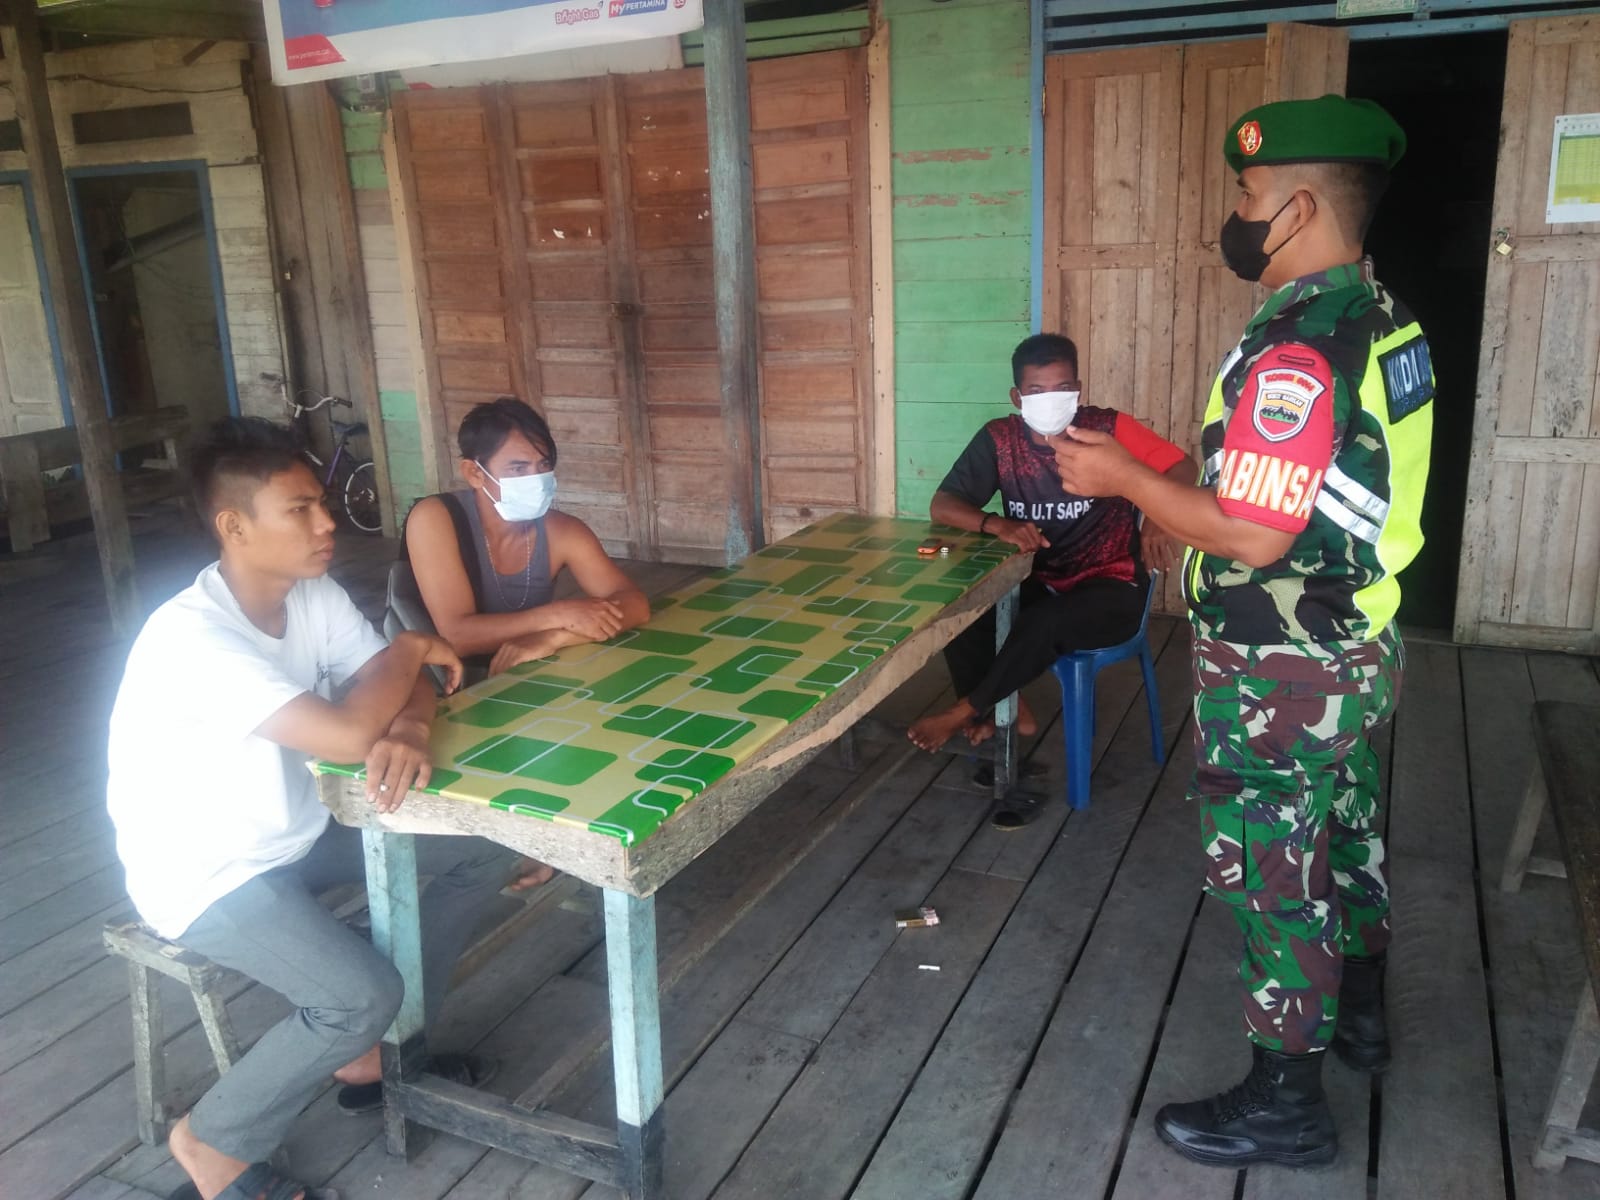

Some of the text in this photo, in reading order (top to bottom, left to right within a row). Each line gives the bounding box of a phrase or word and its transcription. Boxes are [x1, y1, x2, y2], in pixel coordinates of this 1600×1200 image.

[555, 8, 600, 24] Bright Gas
[1008, 500, 1028, 519] PB.
[1031, 503, 1055, 520] U.T
